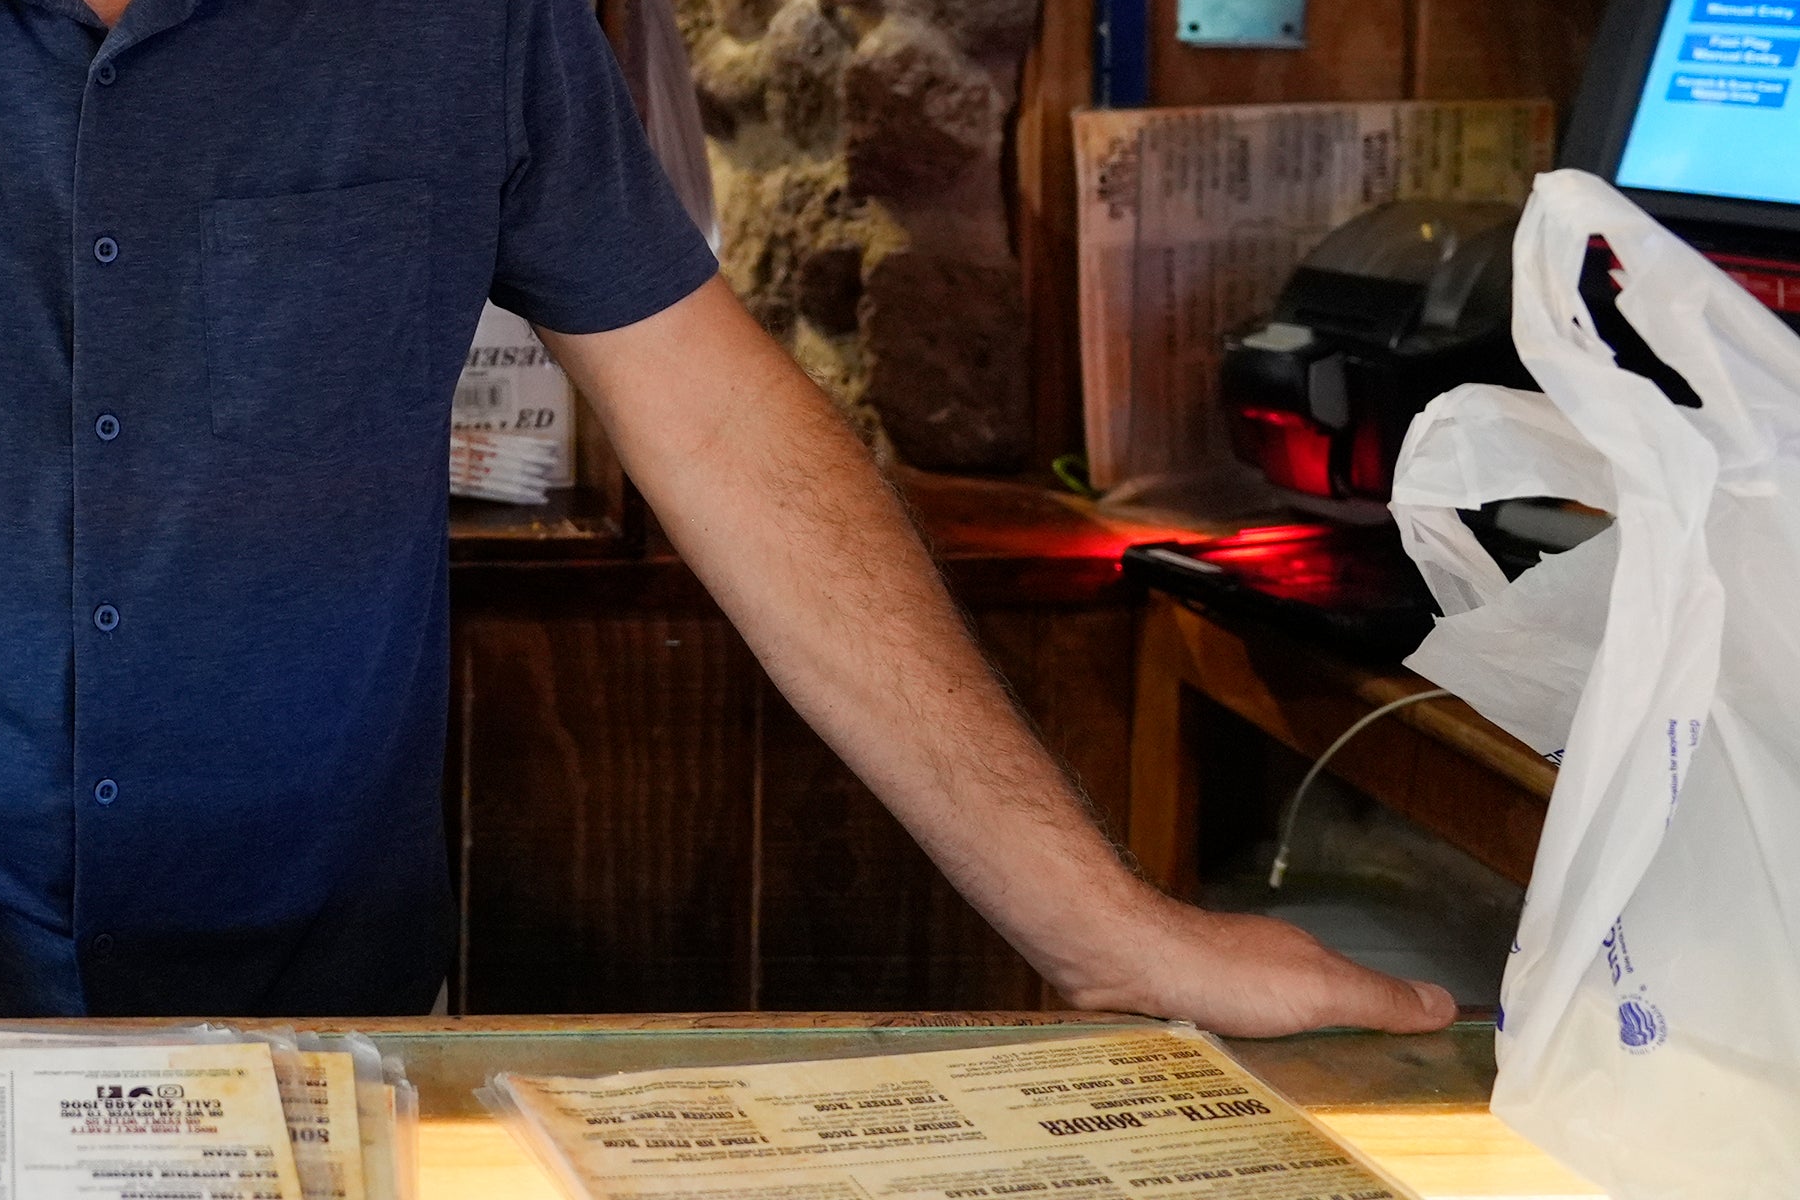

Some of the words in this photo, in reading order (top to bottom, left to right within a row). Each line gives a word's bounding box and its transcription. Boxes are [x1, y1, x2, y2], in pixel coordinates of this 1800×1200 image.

[1108, 1053, 1169, 1067] CARNITAS
[1118, 1077, 1135, 1086] OR
[1138, 1073, 1169, 1084] BEEF
[1020, 1084, 1072, 1096] FAJITAS
[1072, 1079, 1116, 1091] COMBO
[1168, 1091, 1195, 1102] CON
[1196, 1086, 1250, 1099] CEVICHE
[182, 1098, 222, 1109] CALL
[856, 1098, 904, 1109] STREET
[904, 1094, 937, 1105] FISH
[1090, 1094, 1167, 1111] CAMARONES
[813, 1101, 855, 1113] TACOS
[1177, 1098, 1273, 1124] SOUTH
[585, 1115, 627, 1126] TACOS
[630, 1110, 678, 1121] STREET
[679, 1110, 735, 1121] CHICKEN
[912, 1120, 963, 1133] SHRIMP
[1037, 1110, 1149, 1137] BORDER
[816, 1128, 859, 1140] TACOS
[861, 1124, 910, 1136] STREET
[601, 1138, 641, 1149] TACOS
[644, 1138, 693, 1149] STREET
[694, 1138, 717, 1148] RIB
[717, 1135, 759, 1147] PRIME
[1233, 1161, 1289, 1177] FAMOUS
[1127, 1174, 1172, 1188] SALAD
[1172, 1168, 1232, 1183] SPINACH
[943, 1187, 990, 1199] SALAD
[990, 1182, 1049, 1195] CHOPPED
